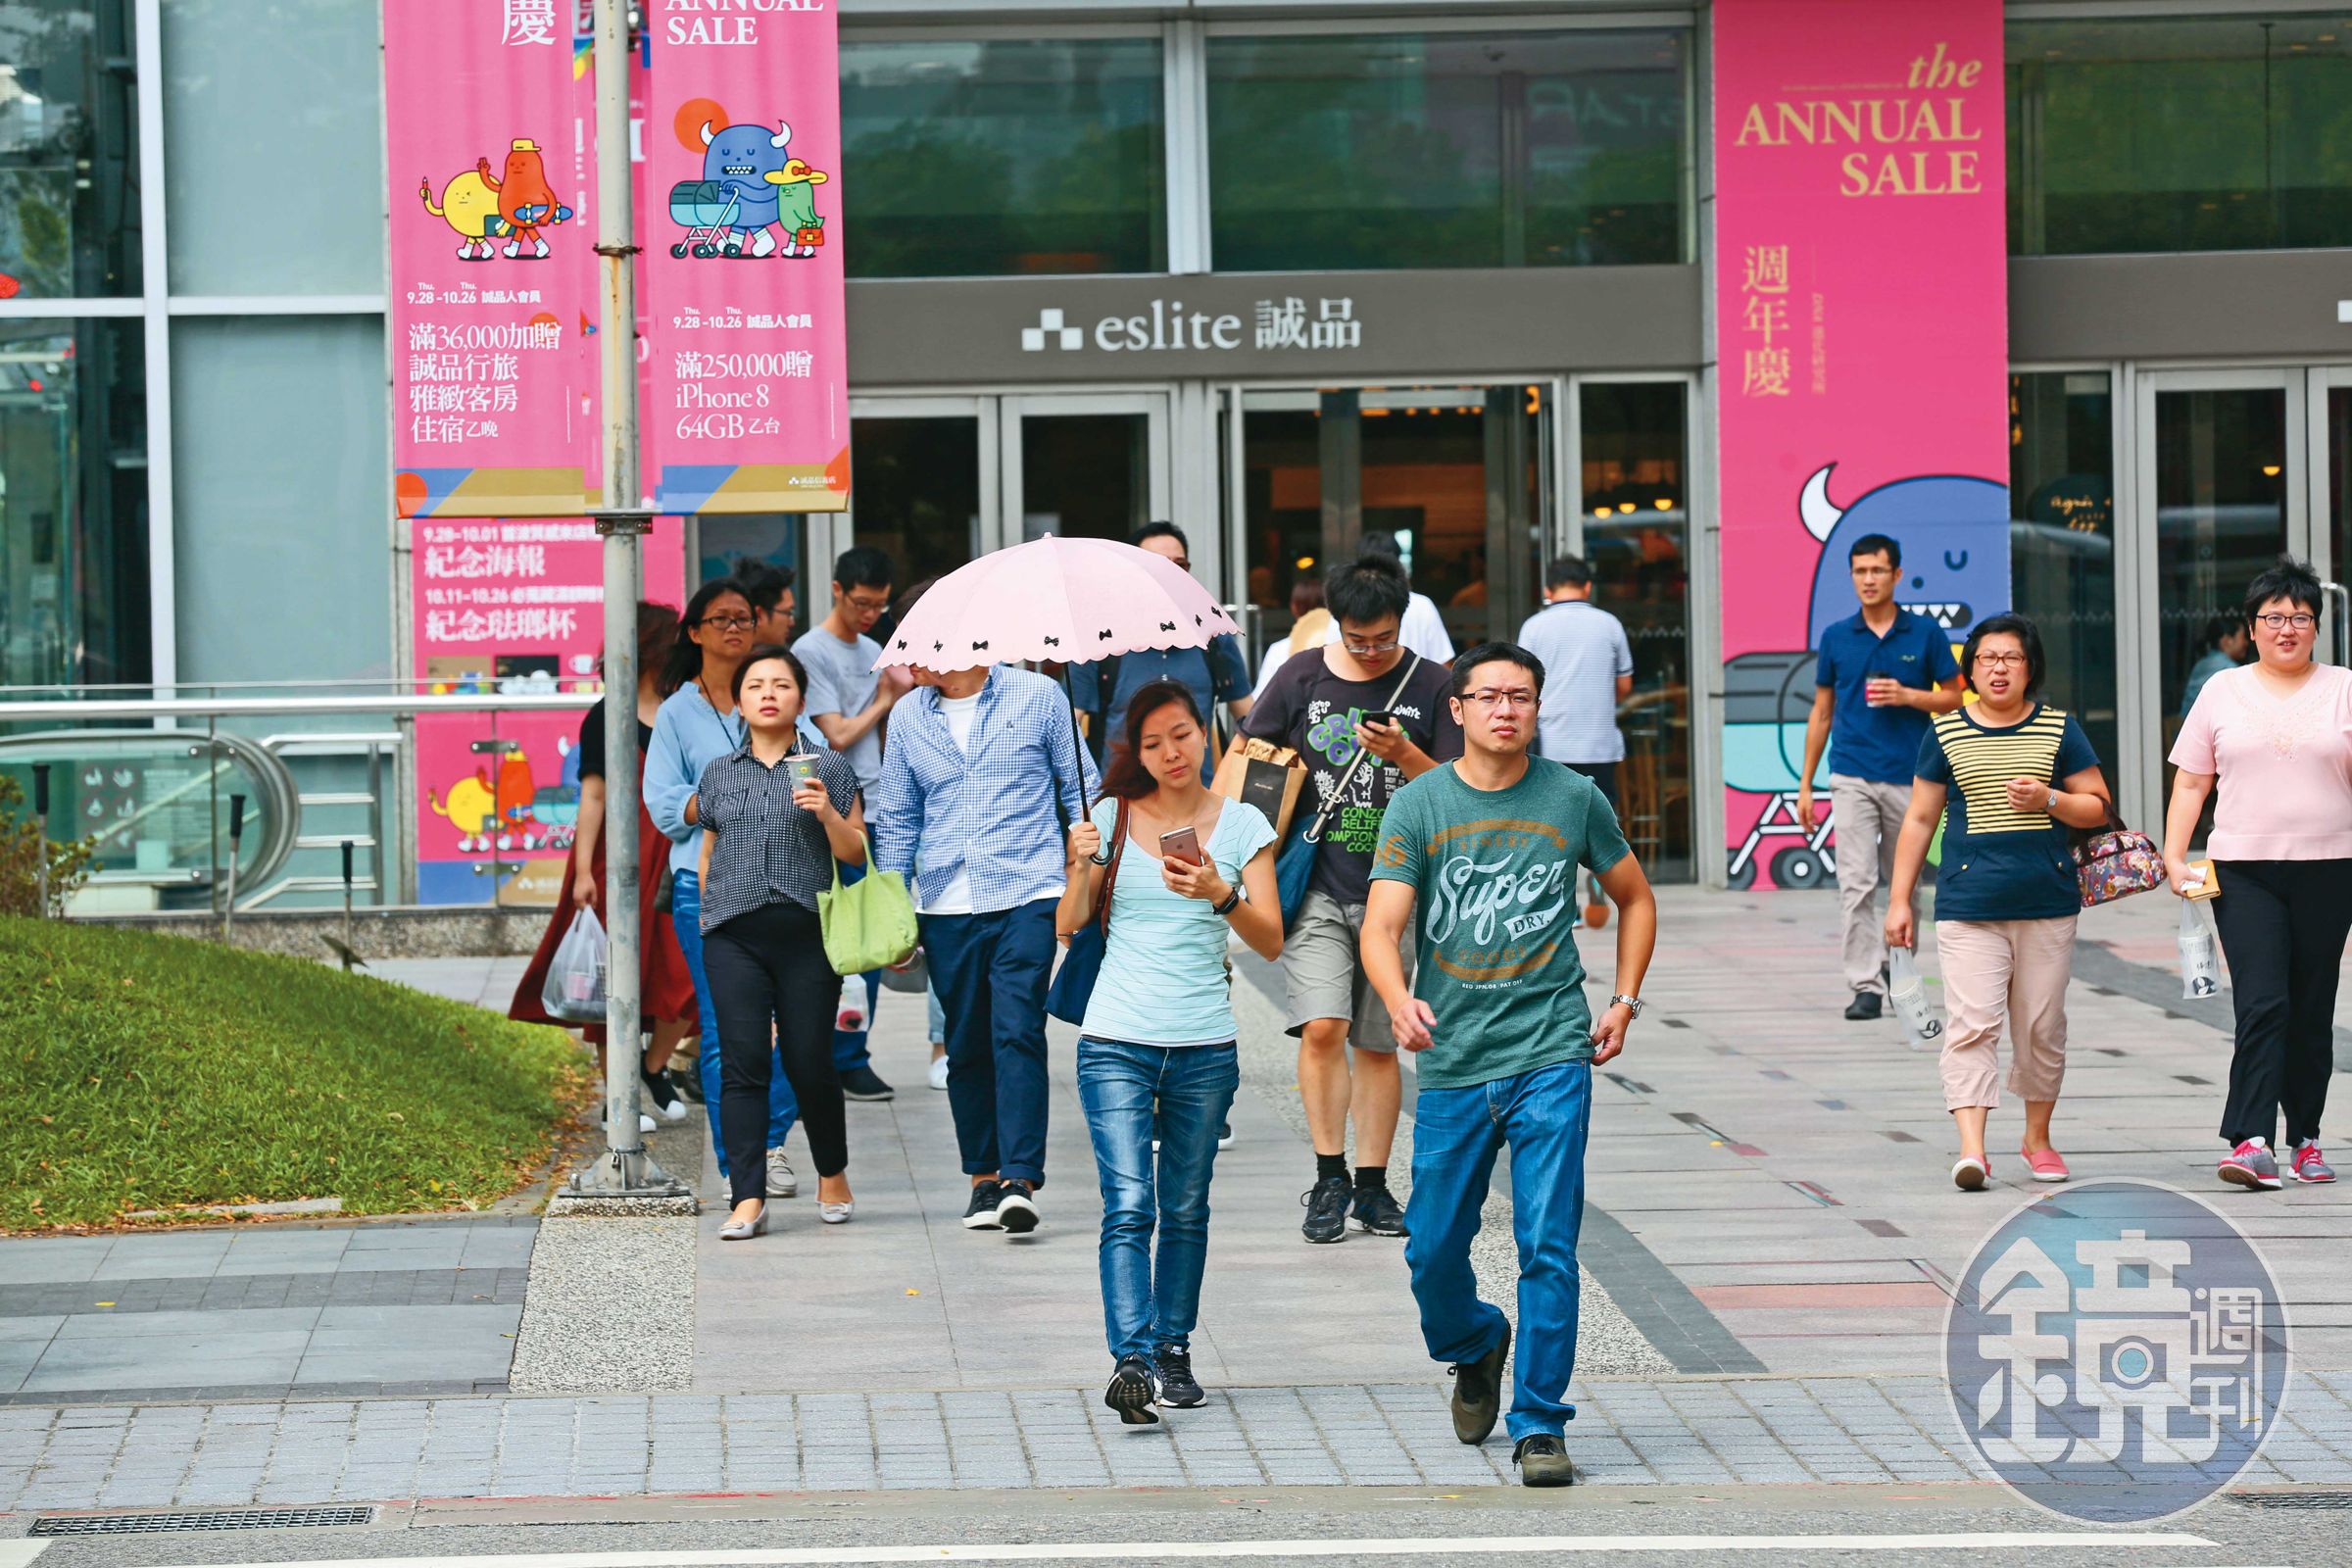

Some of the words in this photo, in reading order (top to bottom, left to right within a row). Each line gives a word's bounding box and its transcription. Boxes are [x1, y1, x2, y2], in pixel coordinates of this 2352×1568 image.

[666, 17, 759, 45] SALE
[1906, 41, 1983, 88] the
[1734, 97, 1983, 146] ANNUAL
[1840, 150, 1983, 197] SALE
[417, 282, 434, 291] Thu.
[461, 281, 477, 290] Thu.
[482, 290, 542, 304] 誠品人會員
[747, 315, 812, 329] 誠品人會員
[1095, 299, 1242, 352] eslite
[1255, 297, 1362, 350] 誠品
[1741, 244, 1791, 397] 週年慶
[409, 321, 563, 352] 滿36,000加贈
[409, 353, 519, 382] 誠品行旅
[674, 350, 813, 380] 滿250,000贈
[409, 383, 518, 413] 雅緻客房
[675, 382, 753, 409] iPhone
[756, 383, 769, 408] 8
[676, 414, 745, 439] 64GB
[749, 417, 781, 434] 乙台
[424, 544, 546, 578] 紀念海報
